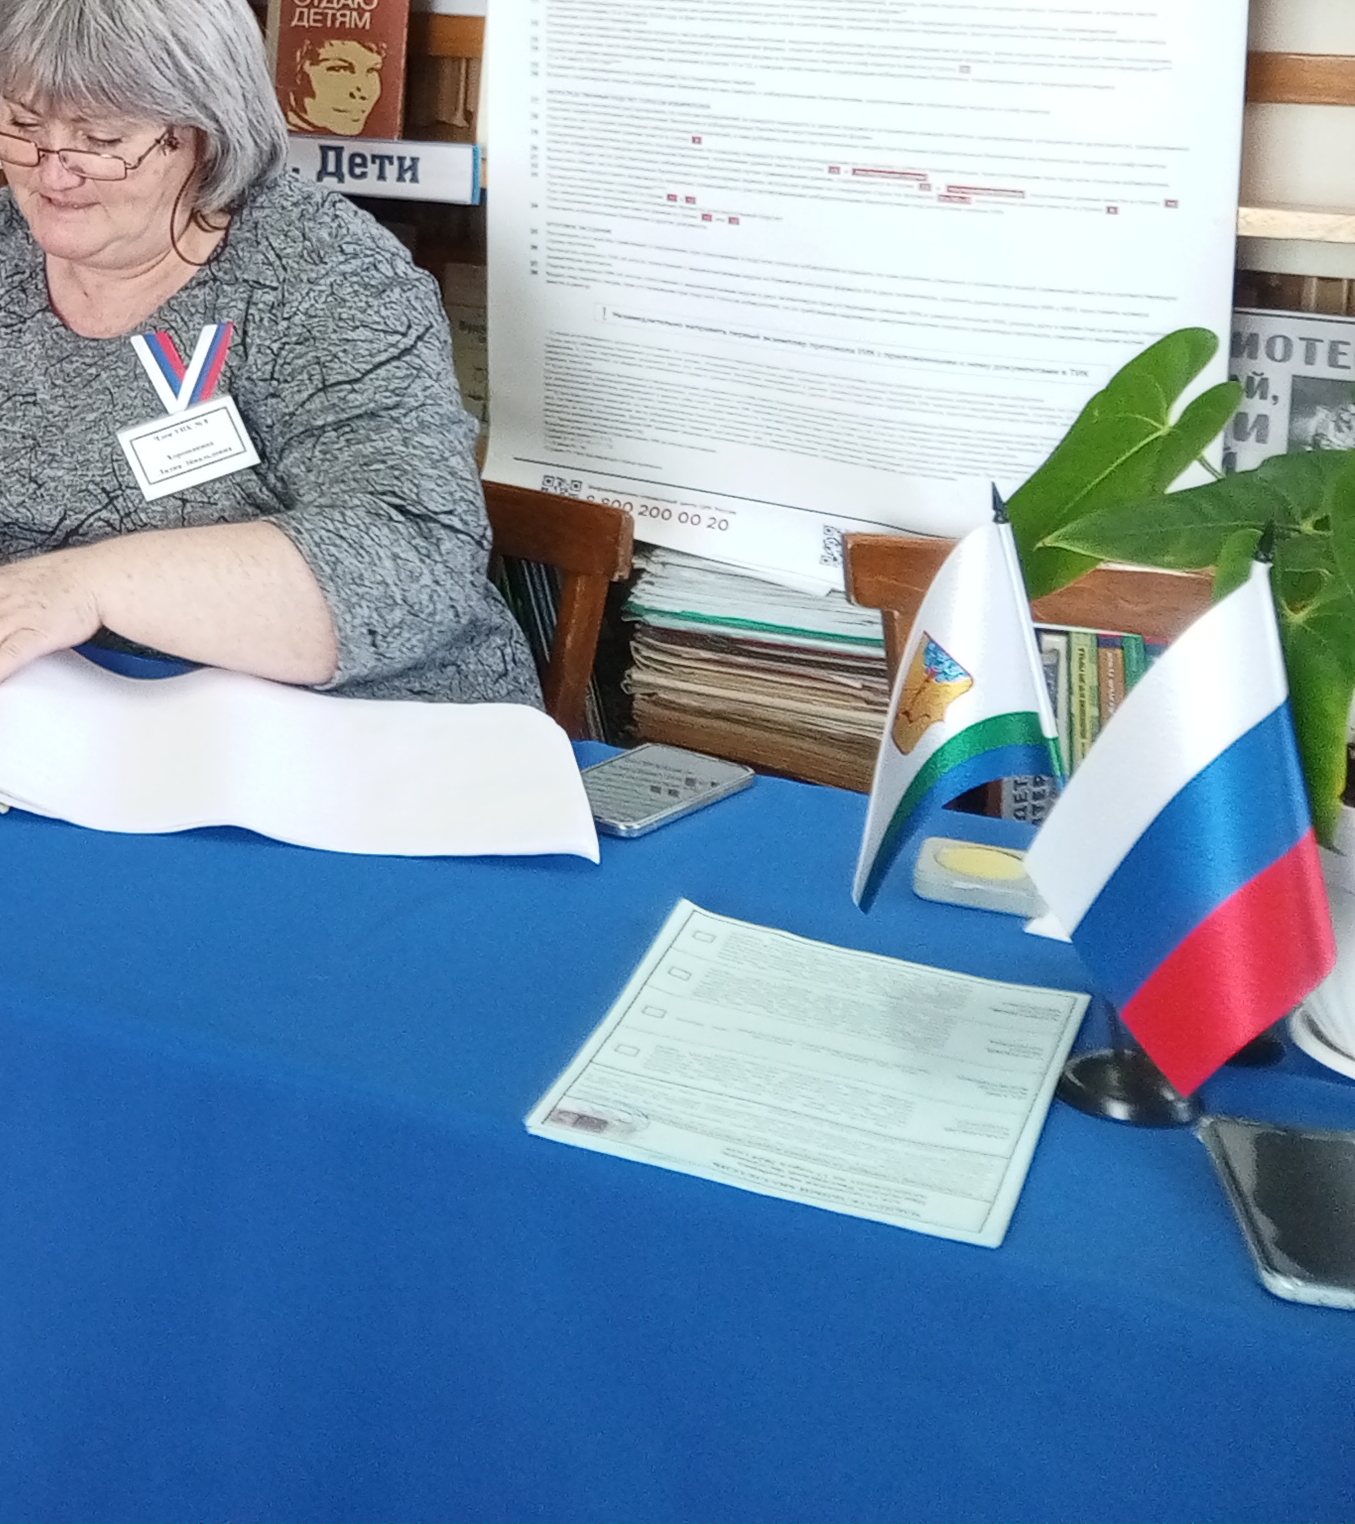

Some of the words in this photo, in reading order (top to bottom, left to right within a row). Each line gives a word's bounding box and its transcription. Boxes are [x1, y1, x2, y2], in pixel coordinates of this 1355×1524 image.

[291, 8, 371, 30] ДЕТЯМ
[316, 145, 421, 185] Дети
[638, 504, 672, 521] 200
[678, 511, 701, 526] 00
[706, 517, 729, 532] 20
